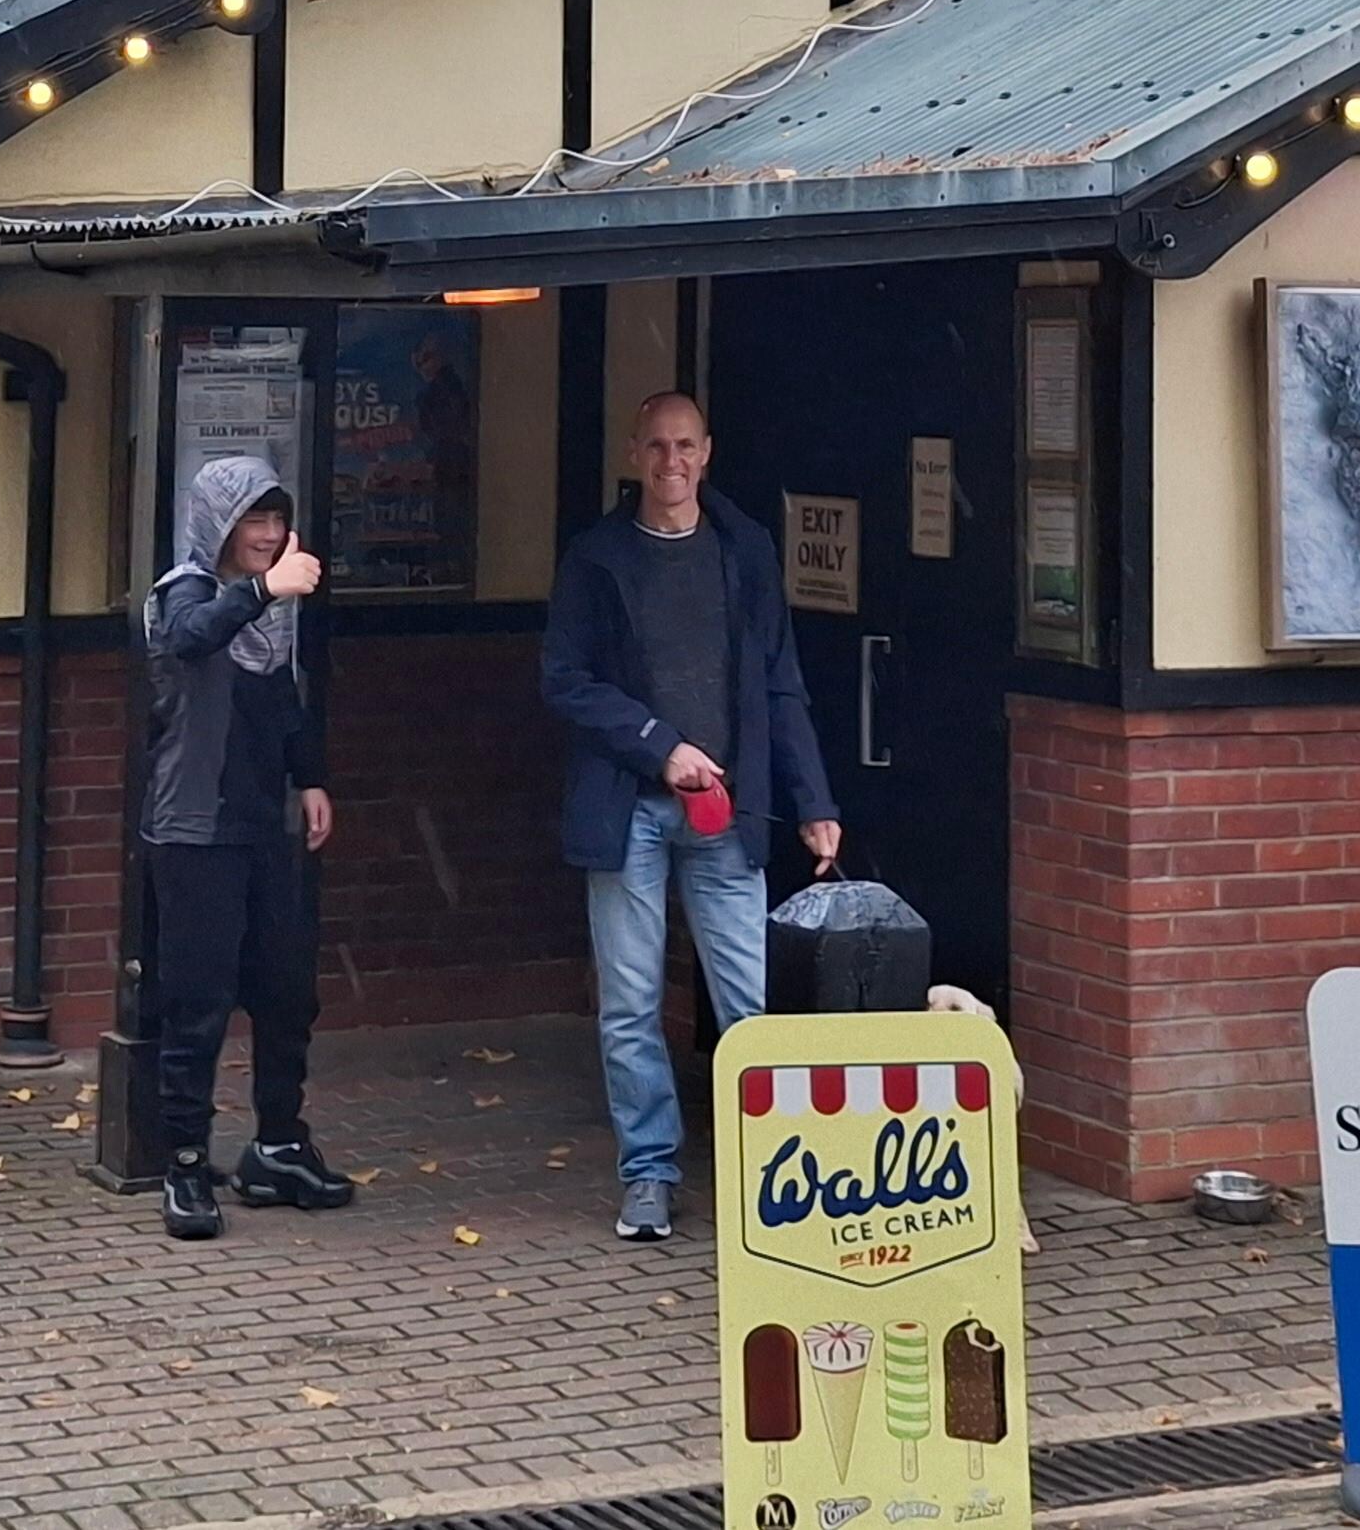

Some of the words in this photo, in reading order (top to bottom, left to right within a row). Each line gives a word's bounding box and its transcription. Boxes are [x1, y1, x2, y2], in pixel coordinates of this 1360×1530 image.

[801, 506, 844, 535] EXIT
[798, 540, 848, 572] ONLY
[758, 1116, 968, 1227] Wall's
[831, 1221, 874, 1246] ICE
[885, 1204, 974, 1236] CREAM
[869, 1244, 912, 1267] 1922
